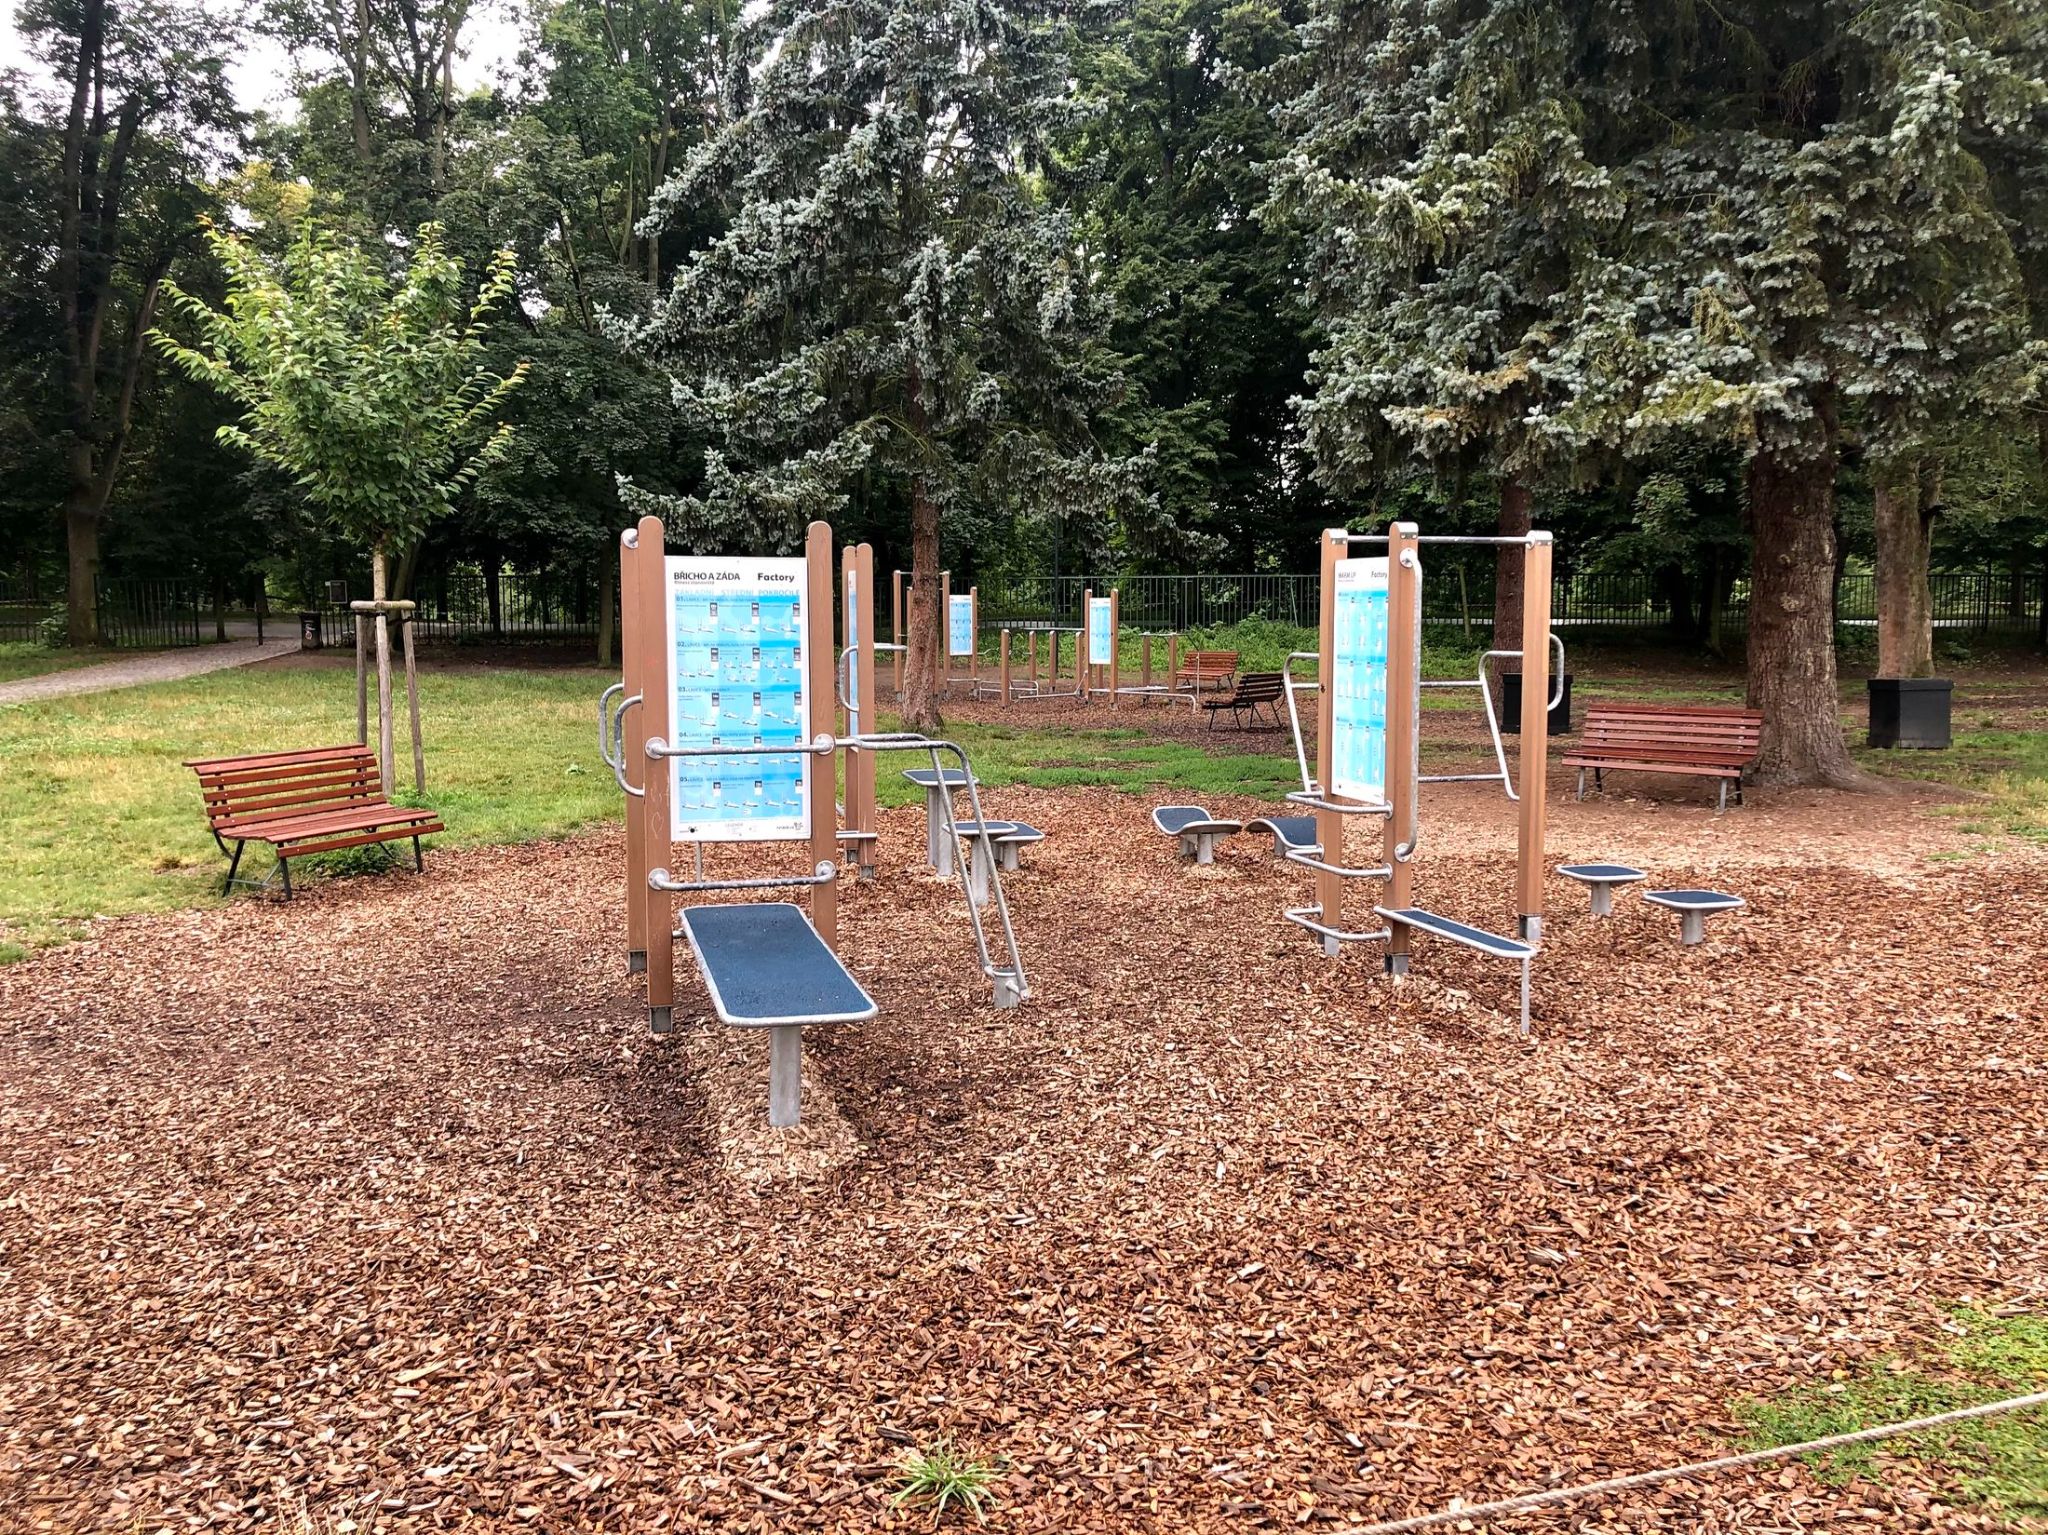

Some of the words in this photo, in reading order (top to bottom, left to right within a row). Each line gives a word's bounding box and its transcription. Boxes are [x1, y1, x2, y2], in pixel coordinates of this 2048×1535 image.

[674, 571, 707, 580] BŘICHO
[716, 571, 740, 580] ZÁDA
[757, 572, 795, 583] Factory
